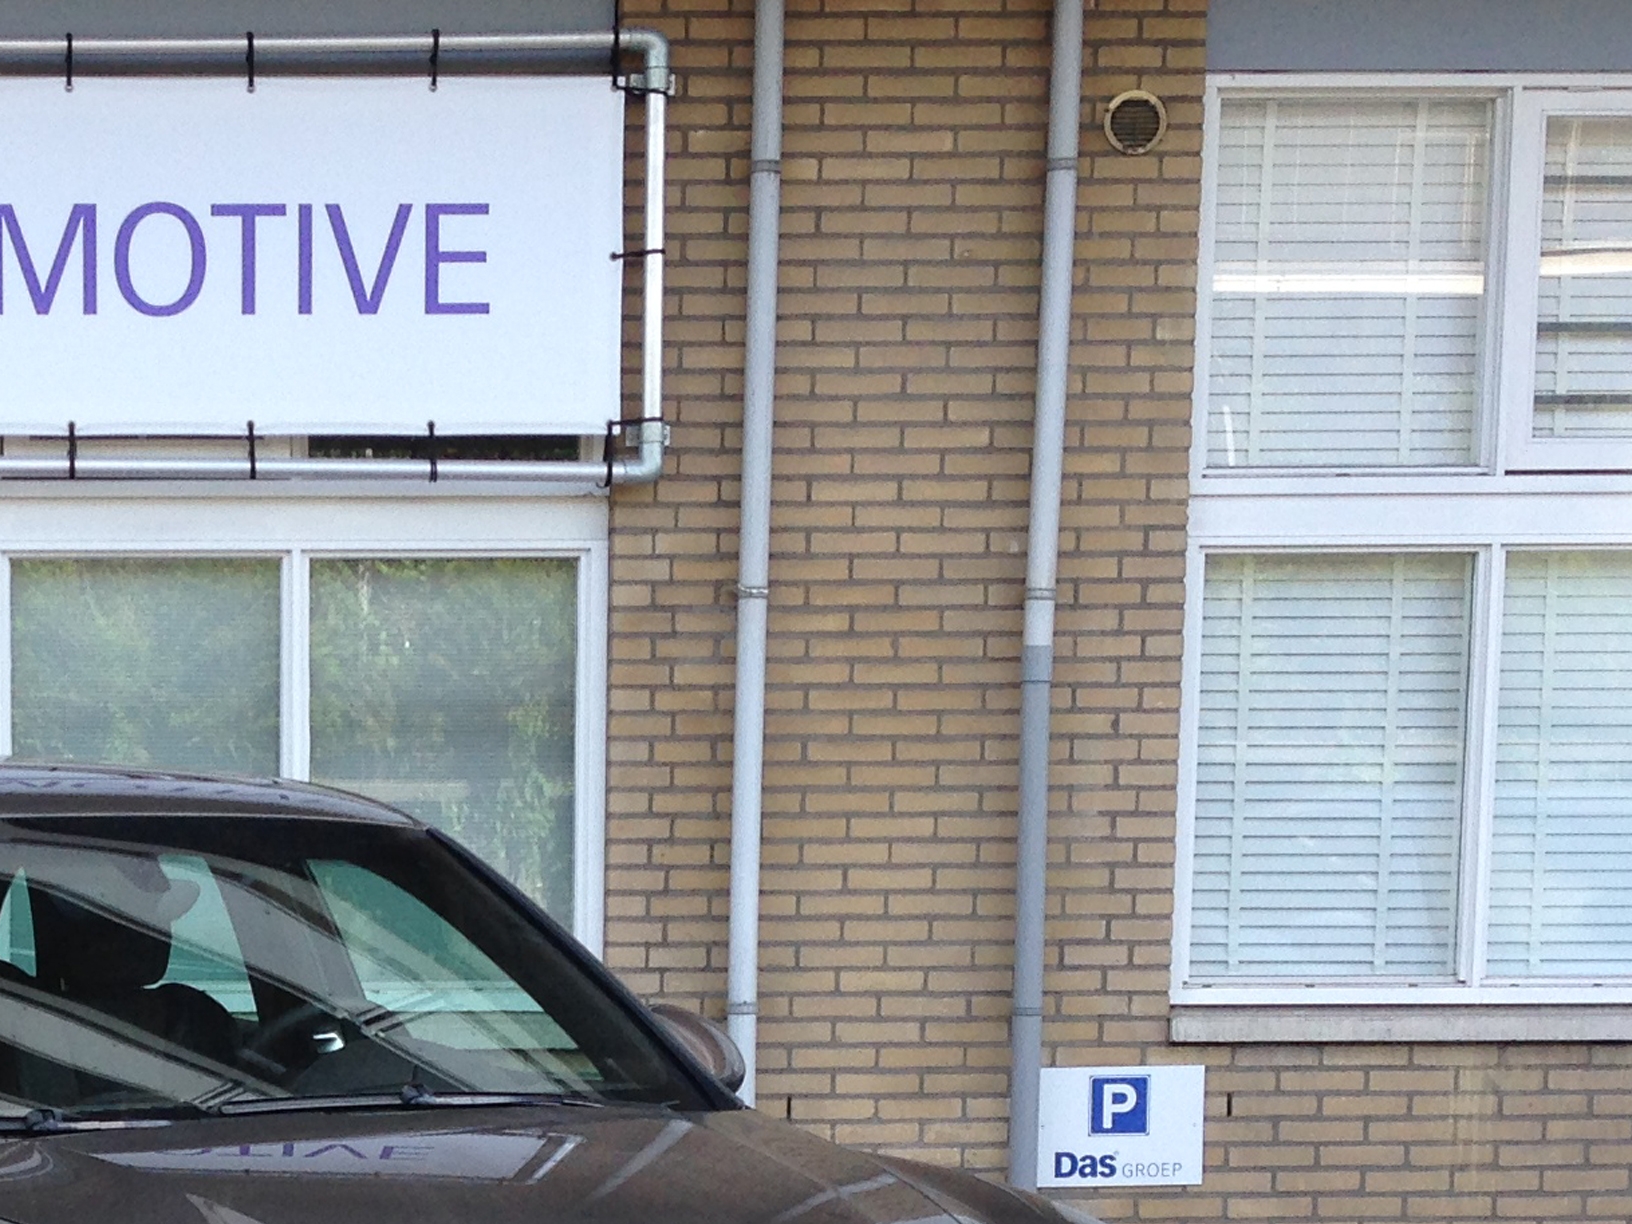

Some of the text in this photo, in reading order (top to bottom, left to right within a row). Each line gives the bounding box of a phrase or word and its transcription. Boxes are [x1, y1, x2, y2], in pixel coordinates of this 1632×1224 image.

[1103, 1084, 1137, 1129] P
[1054, 1151, 1182, 1179] Das GROEP
